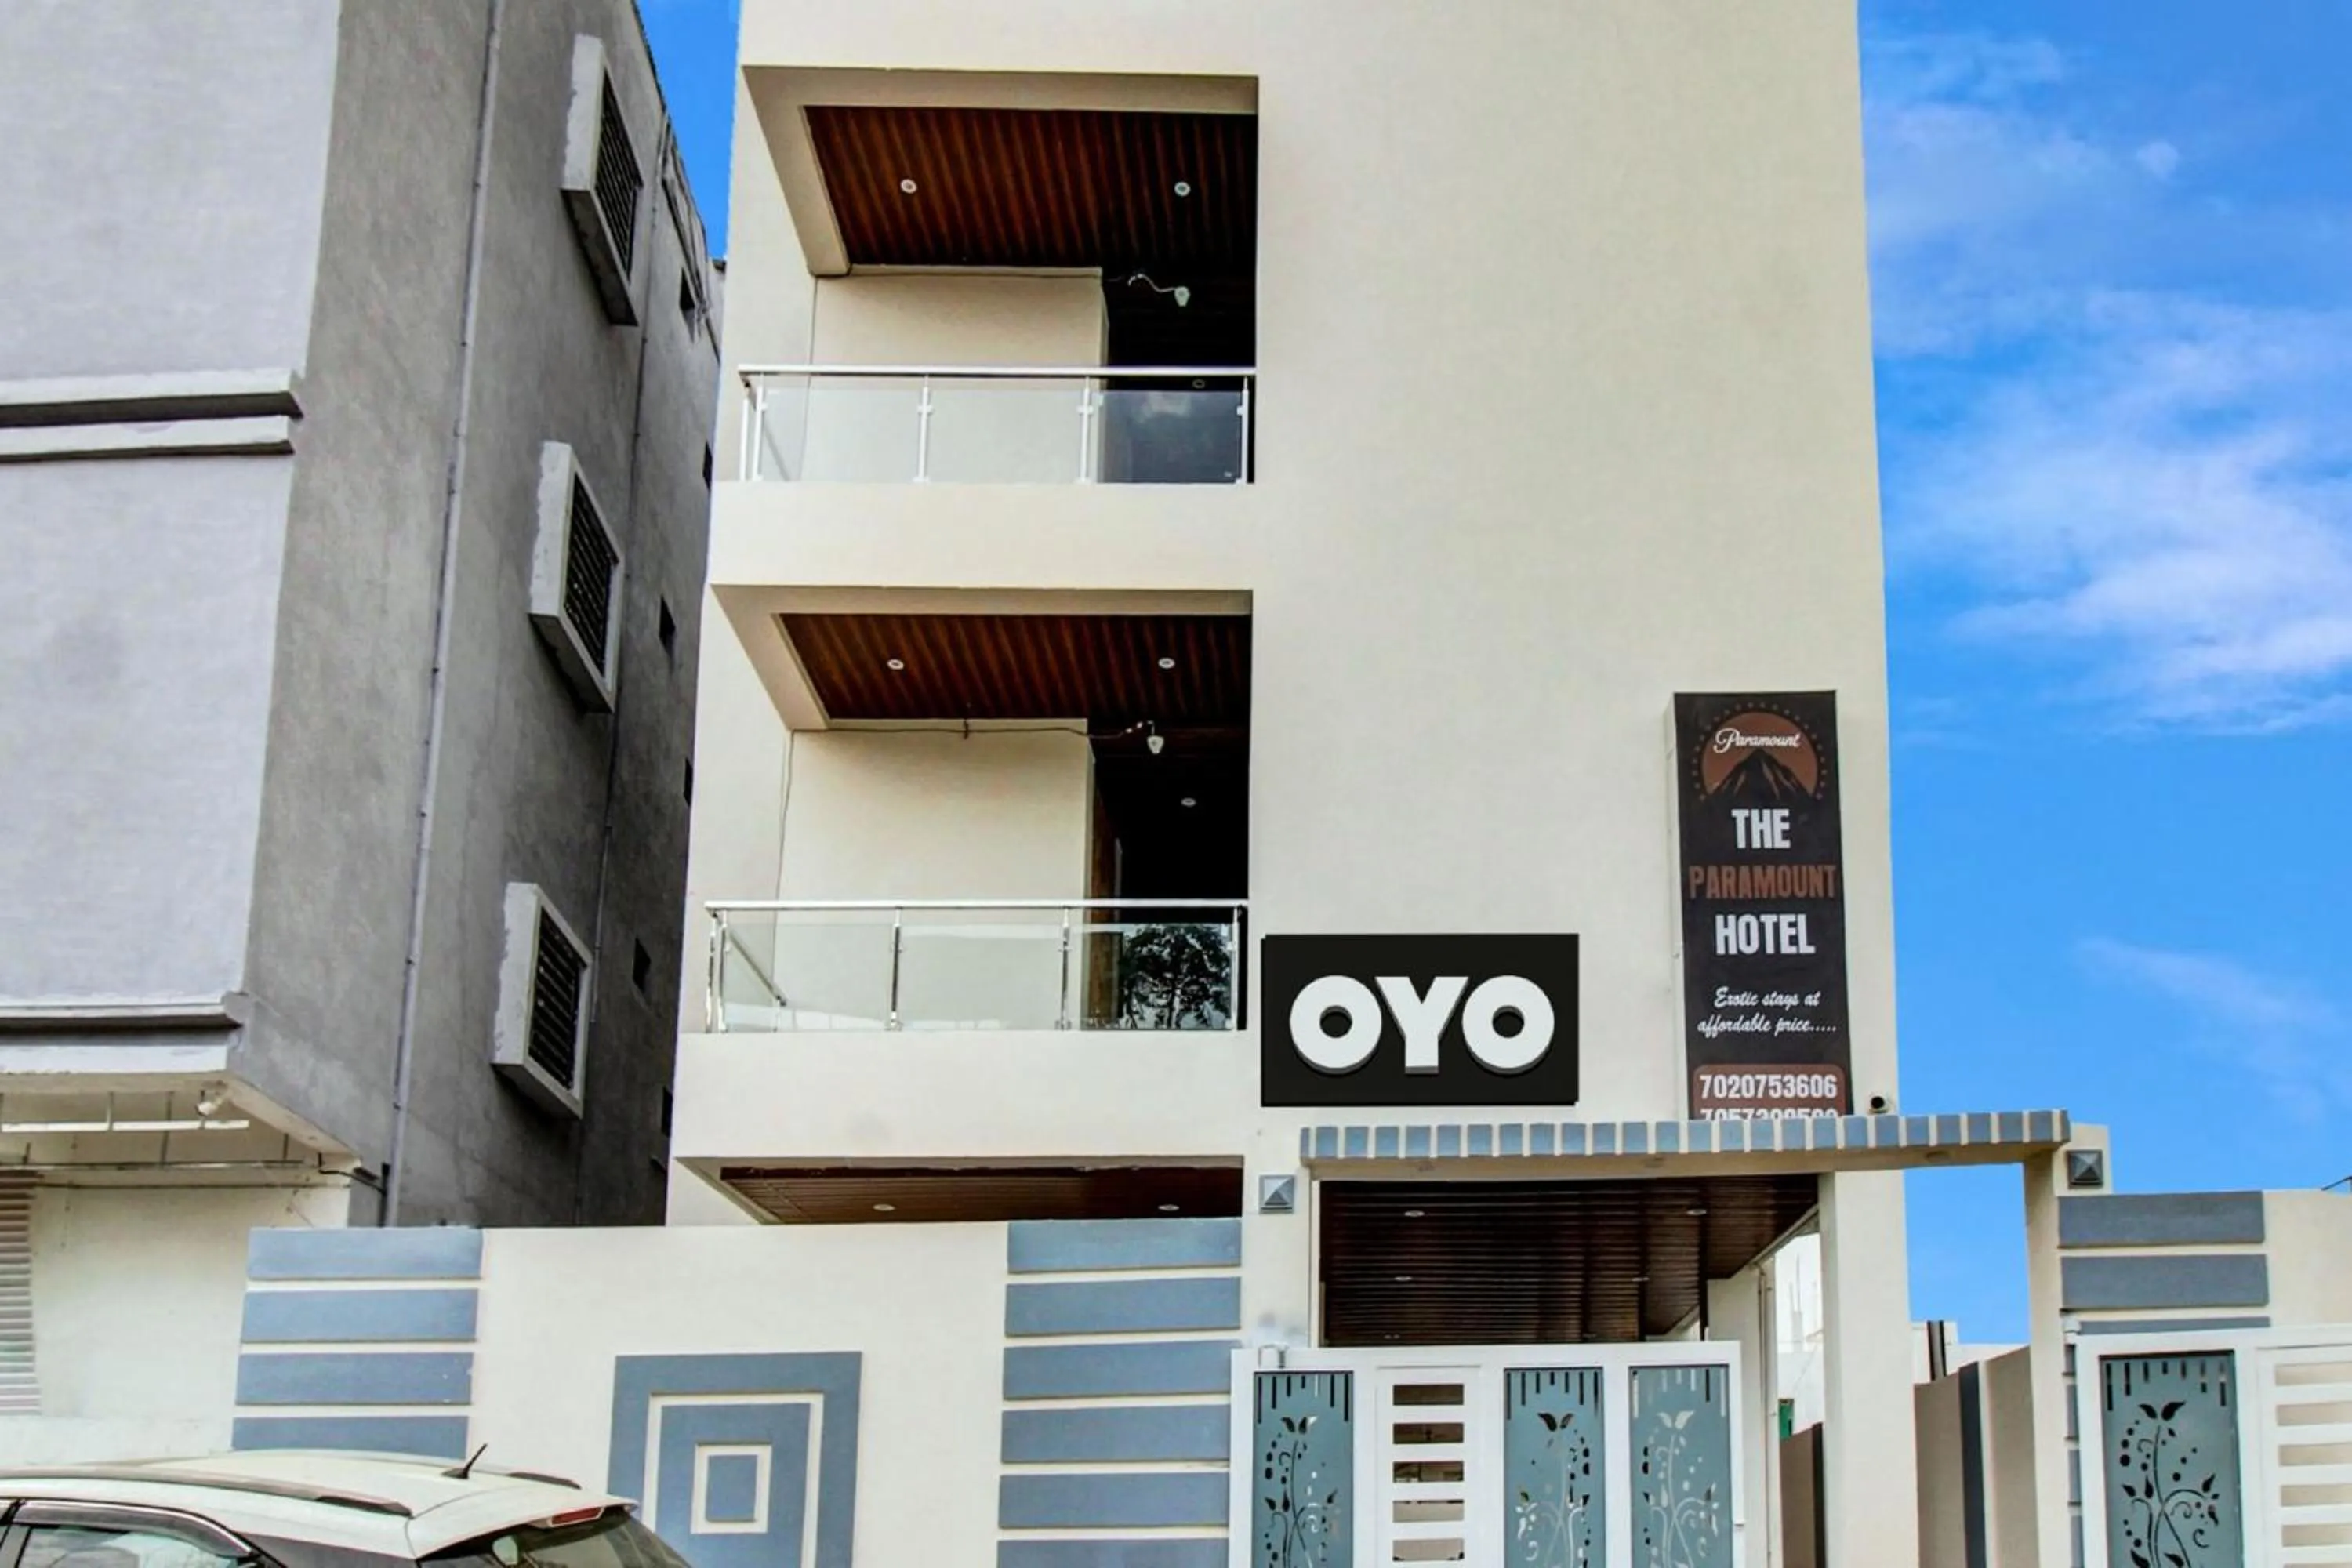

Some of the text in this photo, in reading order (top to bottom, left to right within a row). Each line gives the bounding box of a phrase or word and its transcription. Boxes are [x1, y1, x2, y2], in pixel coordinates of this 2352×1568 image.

[1713, 728, 1801, 753] Paramount
[1731, 808, 1791, 848] THE
[1689, 865, 1837, 899] PARAMOUNT
[1715, 914, 1816, 955] HOTEL
[1714, 986, 1821, 1011] Exotic stays at
[1290, 975, 1555, 1075] OYO
[1697, 1012, 1771, 1038] affordable
[1700, 1074, 1837, 1098] 7020753606
